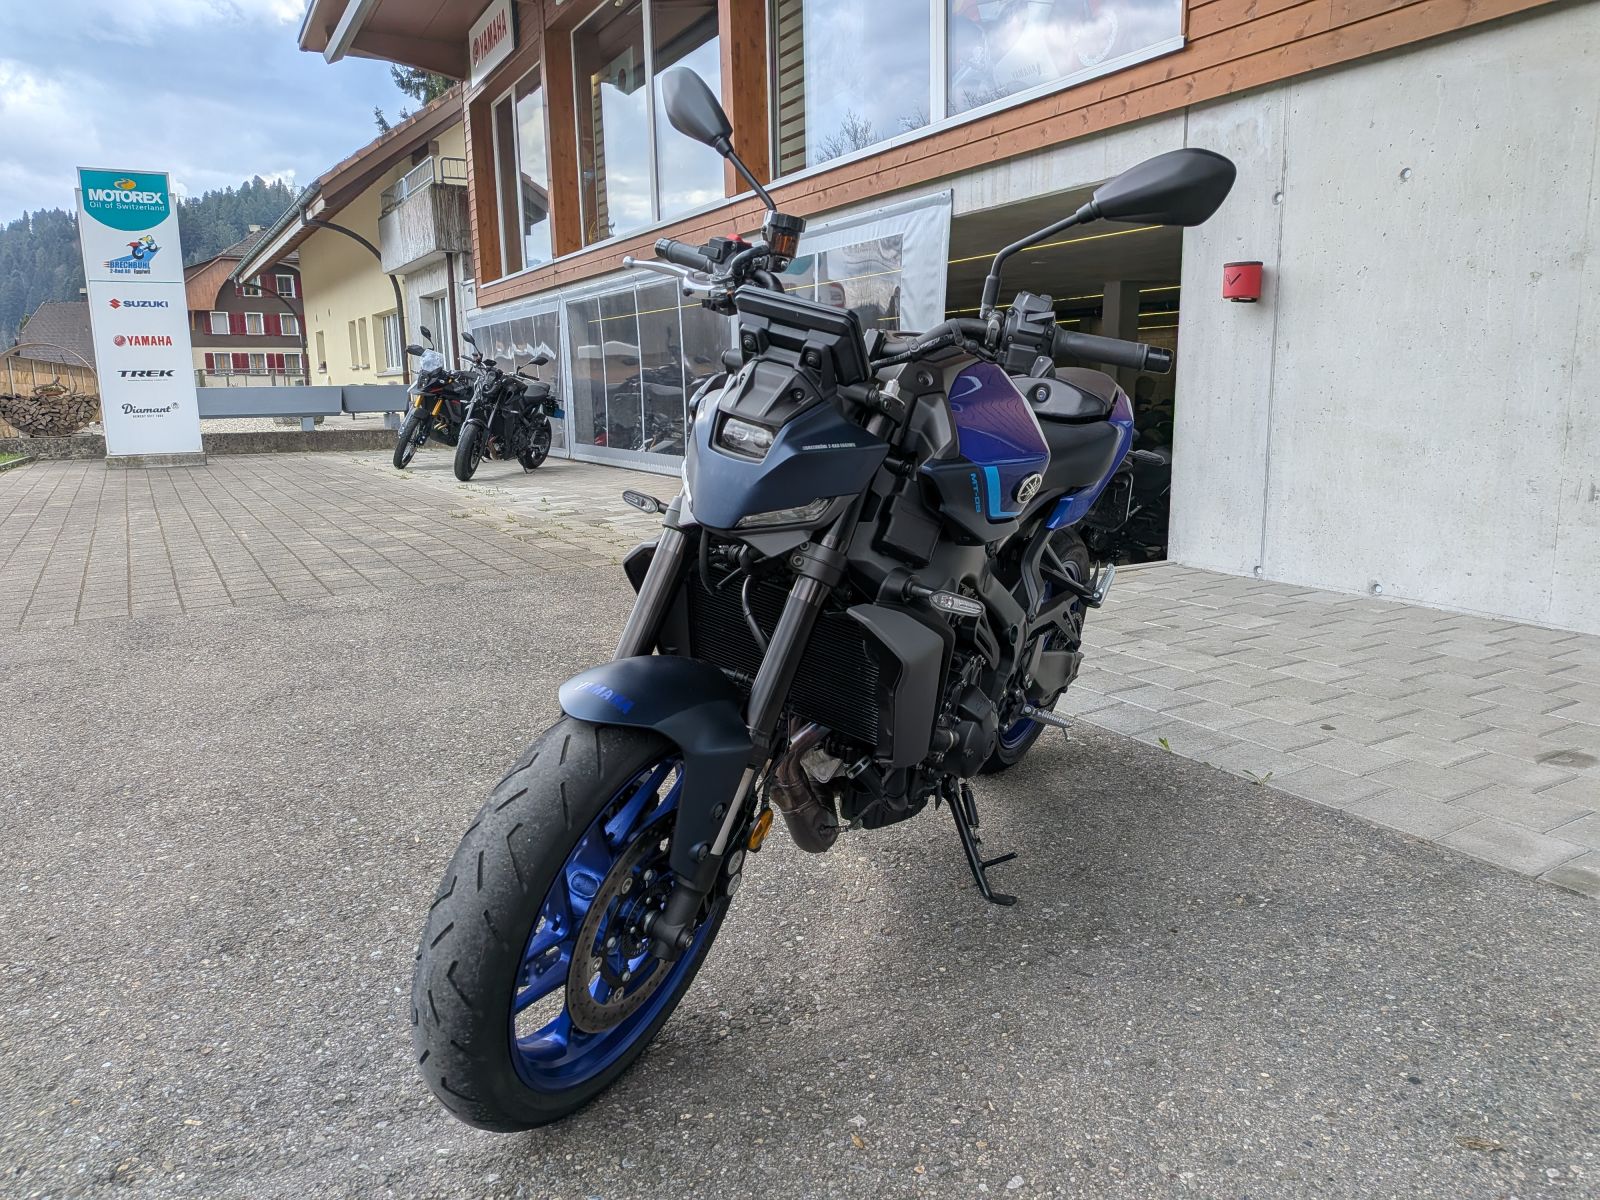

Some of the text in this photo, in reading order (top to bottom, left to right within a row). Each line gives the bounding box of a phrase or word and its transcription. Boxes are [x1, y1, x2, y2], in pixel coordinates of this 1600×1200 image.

[479, 8, 507, 60] YAMAHA
[88, 188, 164, 205] MOTOREX
[89, 200, 102, 208] Oil
[116, 202, 165, 212] Switzerland
[123, 300, 169, 308] SUZUKI
[126, 335, 173, 346] YAMAHA
[116, 369, 176, 378] TREK
[121, 403, 172, 415] Diamant
